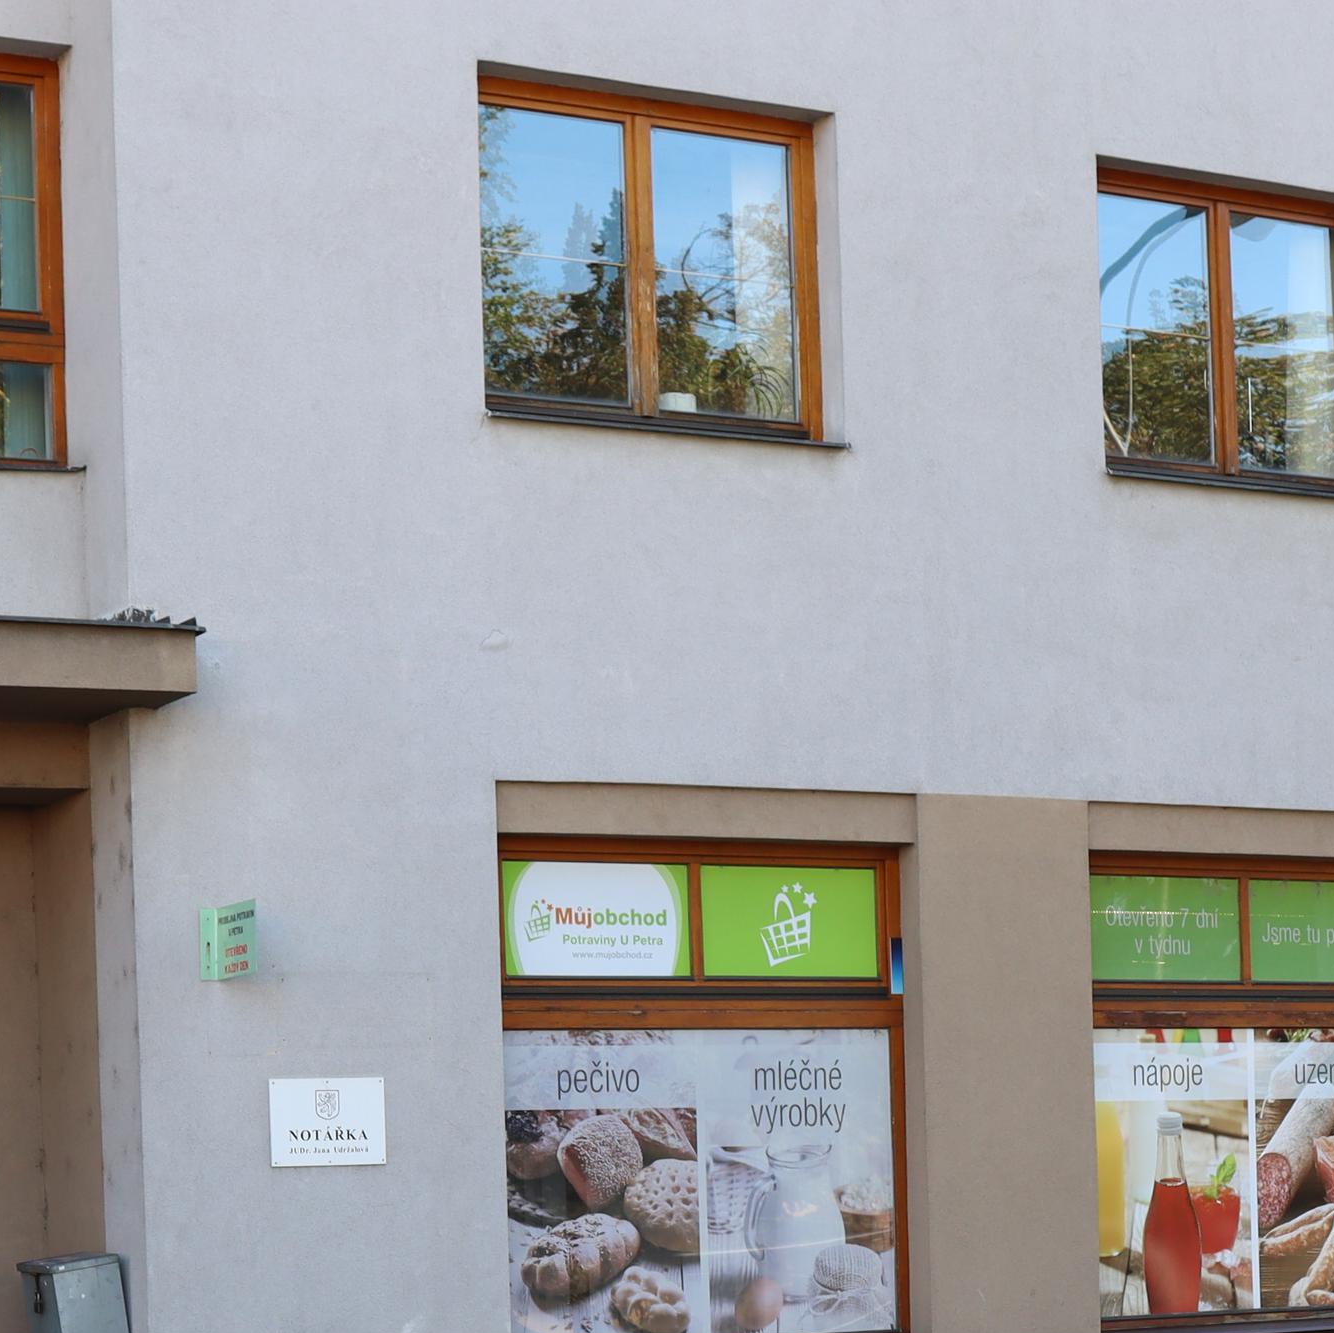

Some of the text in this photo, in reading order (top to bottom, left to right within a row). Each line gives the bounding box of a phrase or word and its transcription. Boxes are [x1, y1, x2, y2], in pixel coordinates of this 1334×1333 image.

[1105, 905, 1219, 929] Otevřeno 7 dní
[562, 934, 663, 947] Potraviny U Petra
[1262, 922, 1301, 943] Jsme
[1307, 924, 1321, 943] tu
[572, 951, 653, 960] www.mujobchod.cz
[1135, 935, 1190, 959] v týdnu
[556, 1060, 640, 1100] pečivo
[754, 1059, 842, 1091] mléčné
[1133, 1057, 1203, 1092] nápoje
[751, 1096, 847, 1134] výrobky
[289, 1126, 368, 1141] NOTÁŘKA
